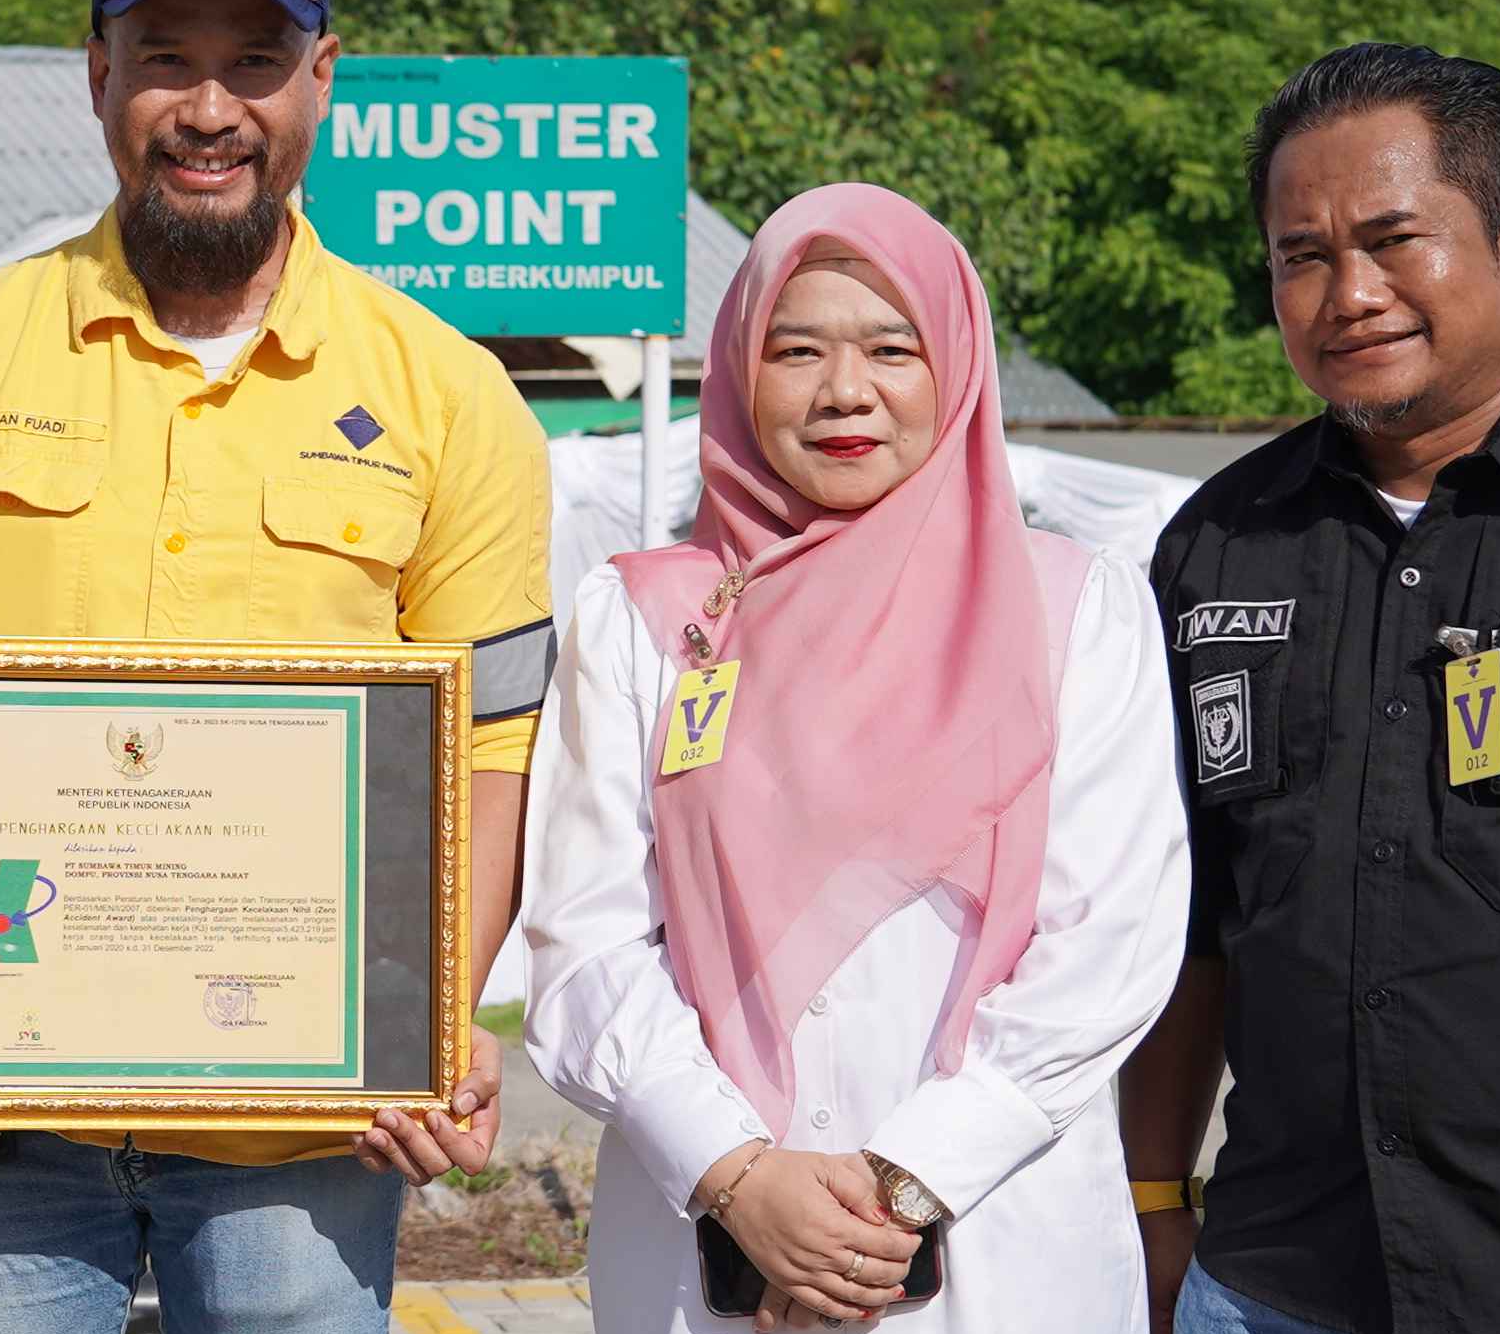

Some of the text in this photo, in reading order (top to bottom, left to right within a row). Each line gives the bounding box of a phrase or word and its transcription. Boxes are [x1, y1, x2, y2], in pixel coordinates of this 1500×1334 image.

[331, 102, 660, 159] MUSTER
[375, 189, 617, 246] POINT
[465, 265, 664, 290] BERKUMPUL
[24, 417, 66, 434] FUADI
[351, 456, 381, 469] TIMUR
[680, 690, 726, 744] V
[1453, 685, 1496, 750] V
[680, 745, 705, 762] 032
[1466, 753, 1488, 771] 012
[57, 788, 212, 798] MENTERI KETENAGAKERJAAN
[78, 801, 191, 810] REPUBLIK INDONESIA
[0, 823, 106, 836] PENGHARGAAN
[223, 825, 271, 837] NIHIL
